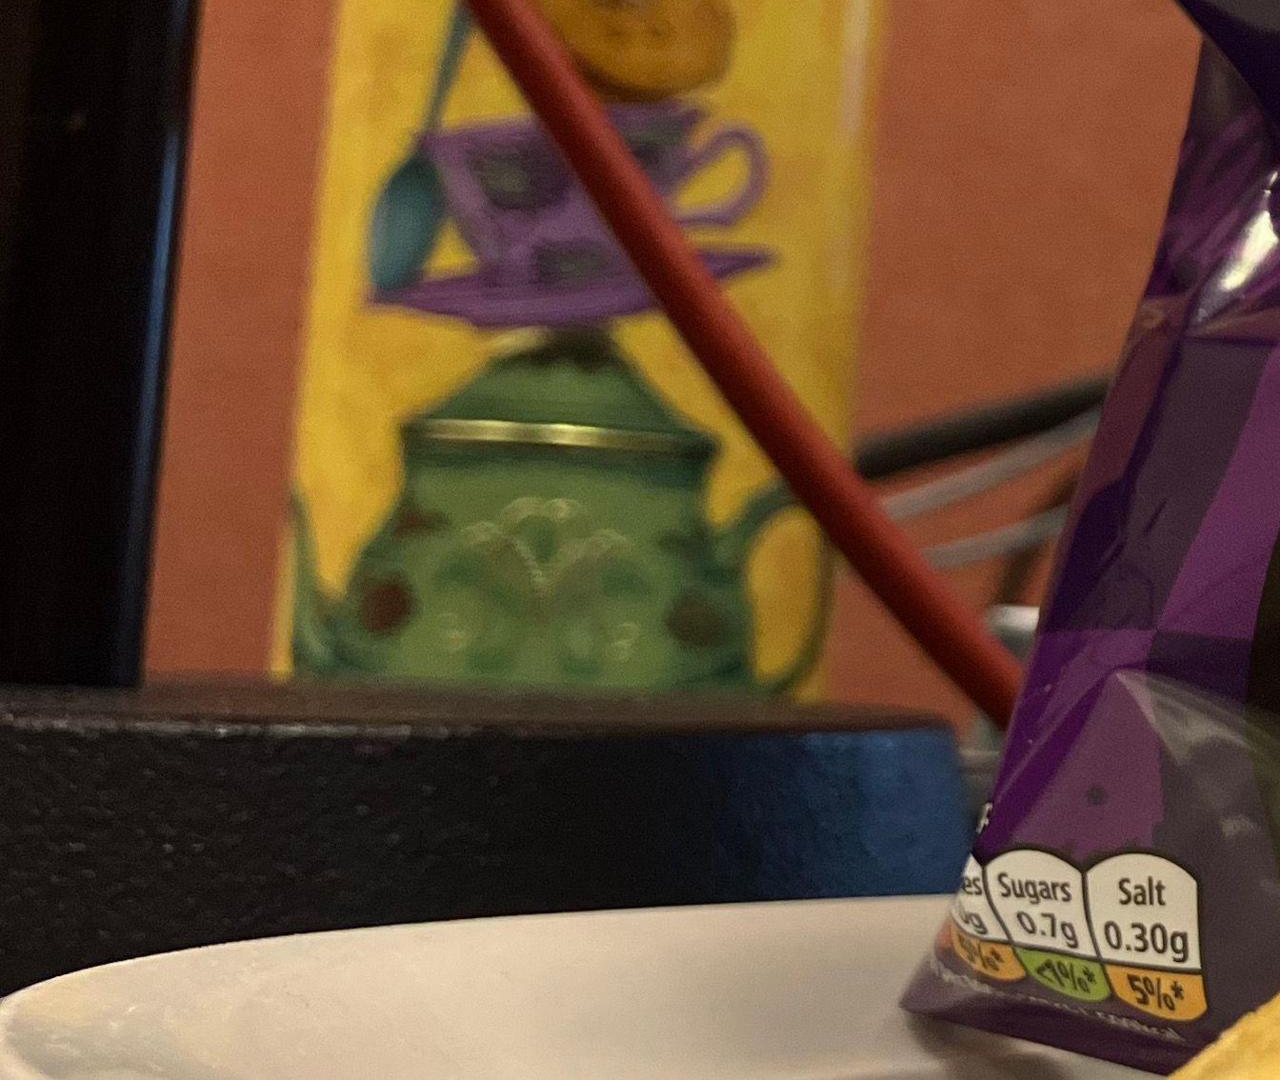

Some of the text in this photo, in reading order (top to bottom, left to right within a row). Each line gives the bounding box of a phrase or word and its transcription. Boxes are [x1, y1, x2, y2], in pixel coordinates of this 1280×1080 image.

[998, 872, 1072, 904] Sugars
[1119, 876, 1166, 906] Salt
[1016, 911, 1078, 948] 0.7g
[1105, 920, 1189, 963] 0.30g
